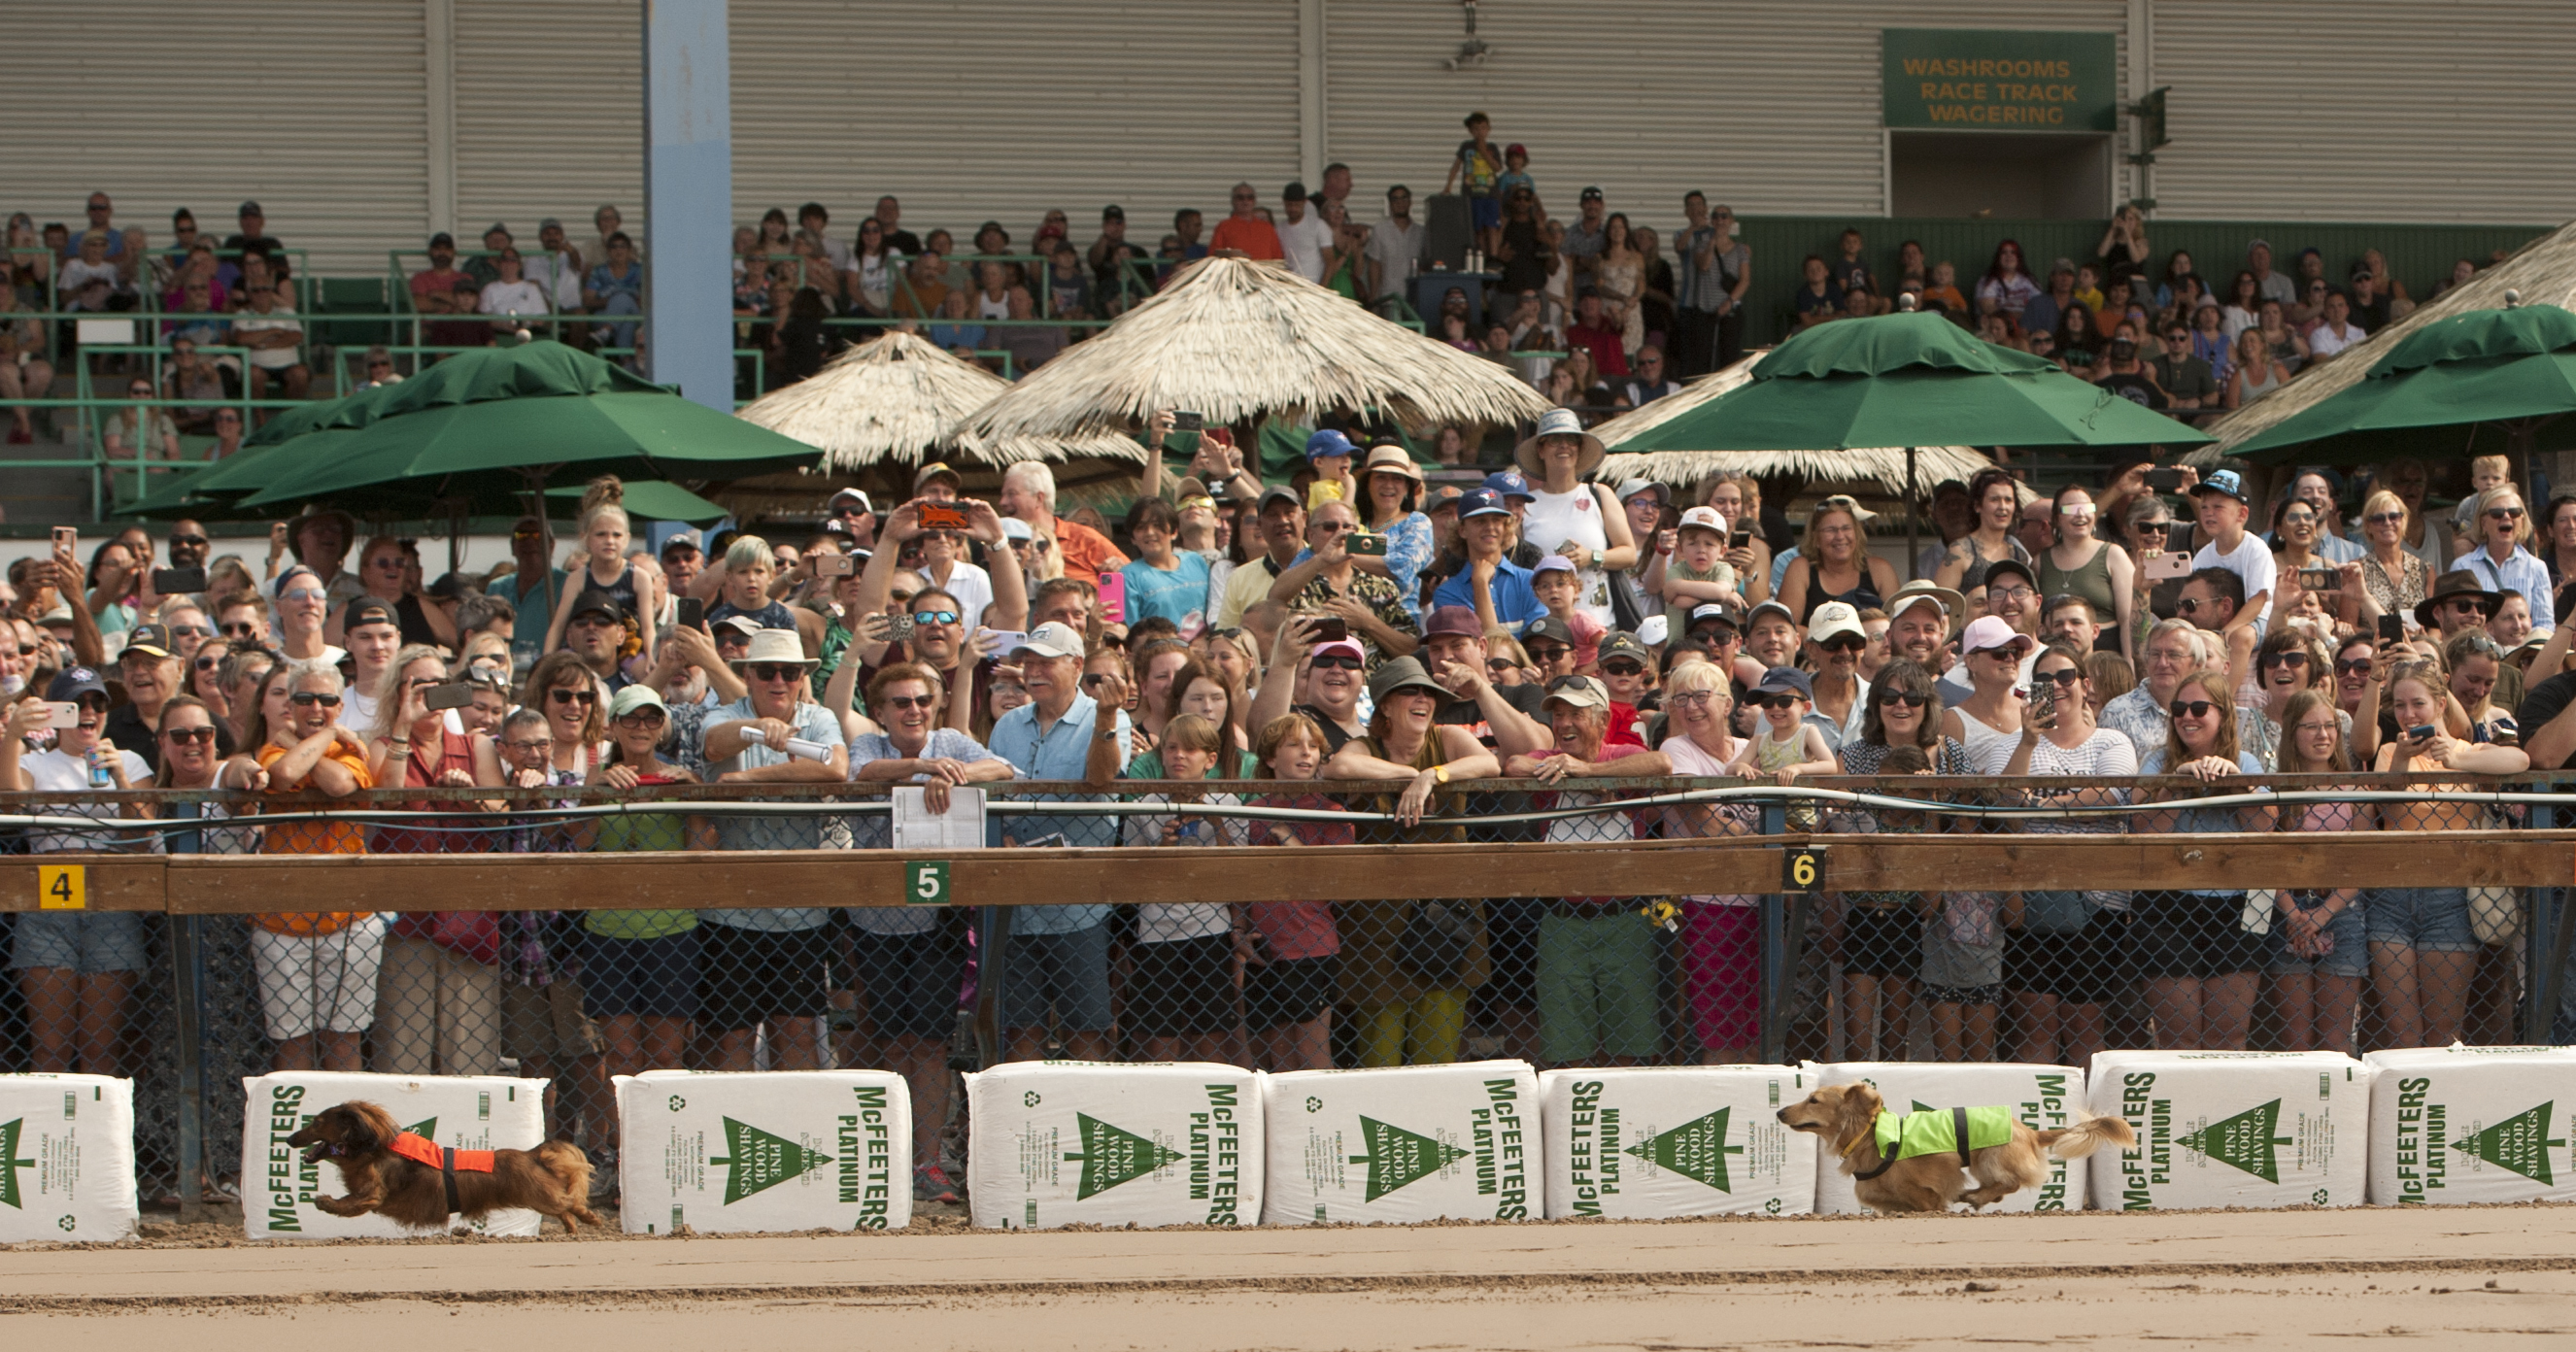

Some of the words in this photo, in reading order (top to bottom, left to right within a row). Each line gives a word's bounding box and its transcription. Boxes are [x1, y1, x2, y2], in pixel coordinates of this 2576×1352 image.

[1903, 58, 2071, 78] WASHROOMS
[1920, 83, 1986, 101] RACE
[1996, 84, 2078, 102] TRACK
[1928, 104, 2063, 124] WAGERING
[50, 873, 73, 901] 4
[917, 868, 940, 898] 5
[1793, 855, 1815, 885] 6
[269, 1085, 305, 1232] McFEETERS
[739, 1126, 752, 1196] SHAVINGS
[755, 1138, 767, 1184] WOOD
[769, 1143, 781, 1177] PINE
[838, 1115, 859, 1203] PLATINUM
[853, 1086, 888, 1230] McFEETERS
[1092, 1122, 1105, 1192] SHAVINGS
[1108, 1135, 1119, 1180] WOOD
[1122, 1140, 1134, 1174] PINE
[1190, 1113, 1209, 1200] PLATINUM
[1204, 1084, 1238, 1225] McFEETERS
[1376, 1124, 1392, 1193] SHAVINGS
[1391, 1134, 1406, 1180] WOOD
[1407, 1140, 1420, 1174] PINE
[1471, 1108, 1497, 1195] PLATINUM
[1483, 1079, 1528, 1220] McFEETERS
[1571, 1081, 1604, 1217] McFEETERS
[1600, 1108, 1620, 1194] PLATINUM
[1675, 1133, 1687, 1167] PINE
[1690, 1128, 1701, 1173] WOOD
[1704, 1116, 1716, 1184] SHAVINGS
[2151, 1099, 2171, 1184] PLATINUM
[2224, 1125, 2237, 1158] PINE
[2238, 1119, 2251, 1164] WOOD
[2253, 1108, 2266, 1175] SHAVINGS
[2426, 1104, 2446, 1188] PLATINUM
[2499, 1128, 2510, 1161] PINE
[2513, 1122, 2524, 1166] WOOD
[2527, 1110, 2538, 1177] SHAVINGS
